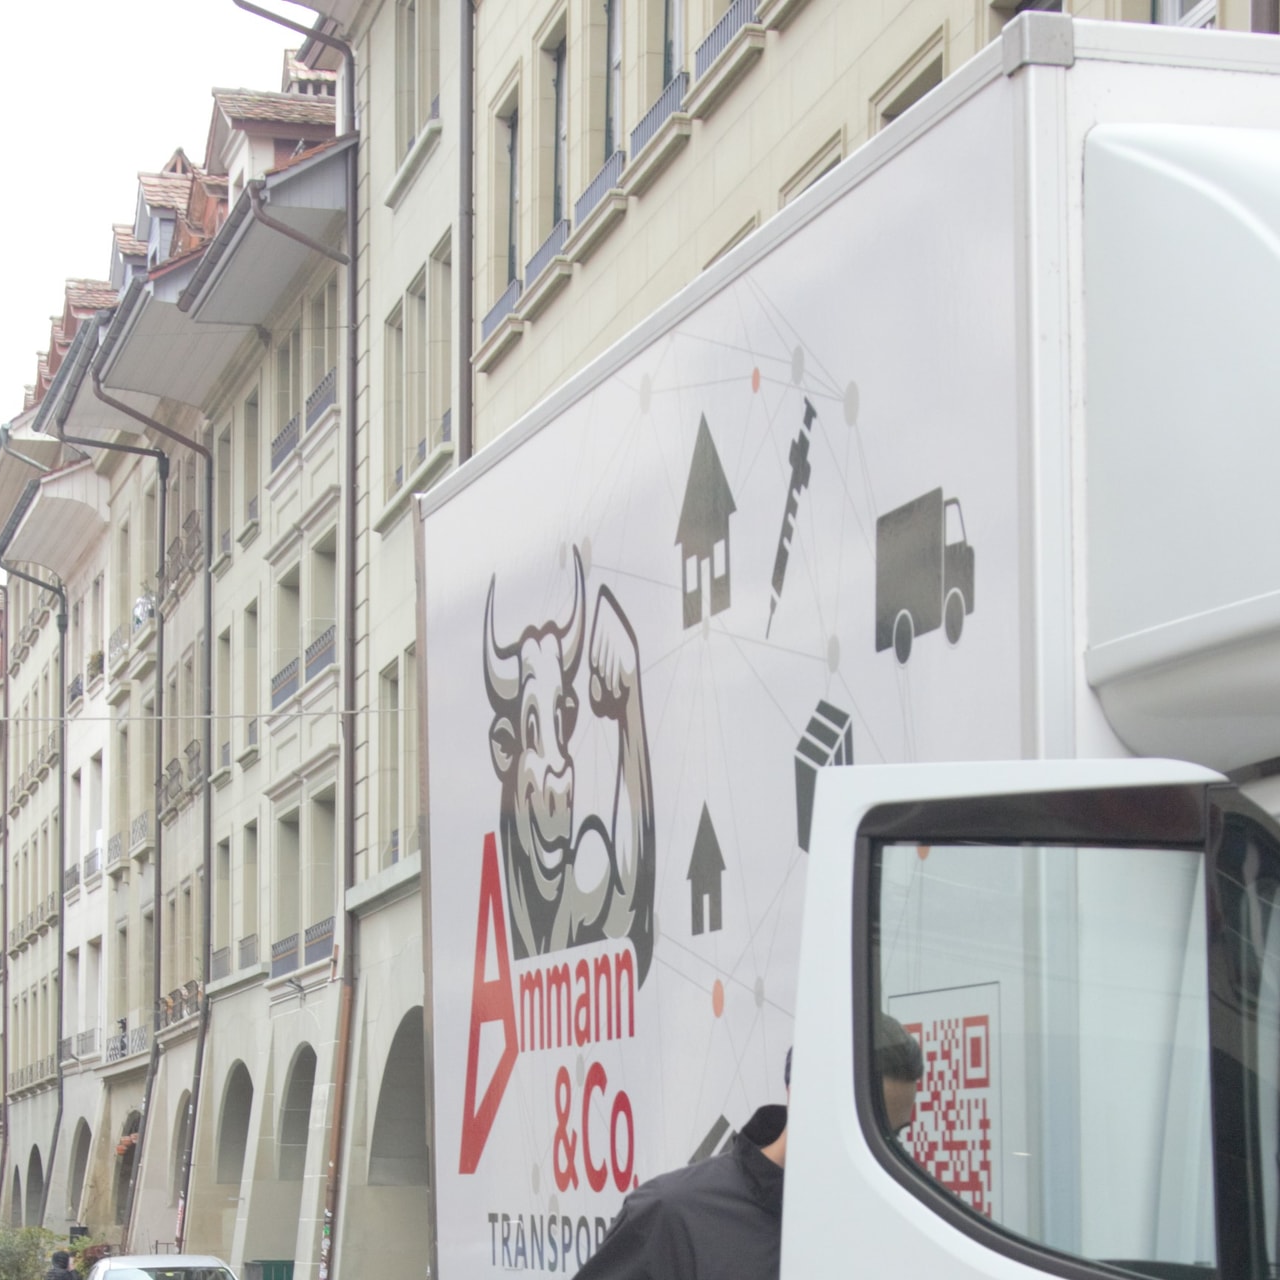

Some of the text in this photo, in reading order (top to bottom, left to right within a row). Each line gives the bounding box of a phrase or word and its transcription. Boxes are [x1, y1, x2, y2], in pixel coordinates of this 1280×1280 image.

[458, 832, 635, 1175] Ammann
[553, 1062, 639, 1194] &Co.
[487, 1212, 617, 1273] TRANSPOR
